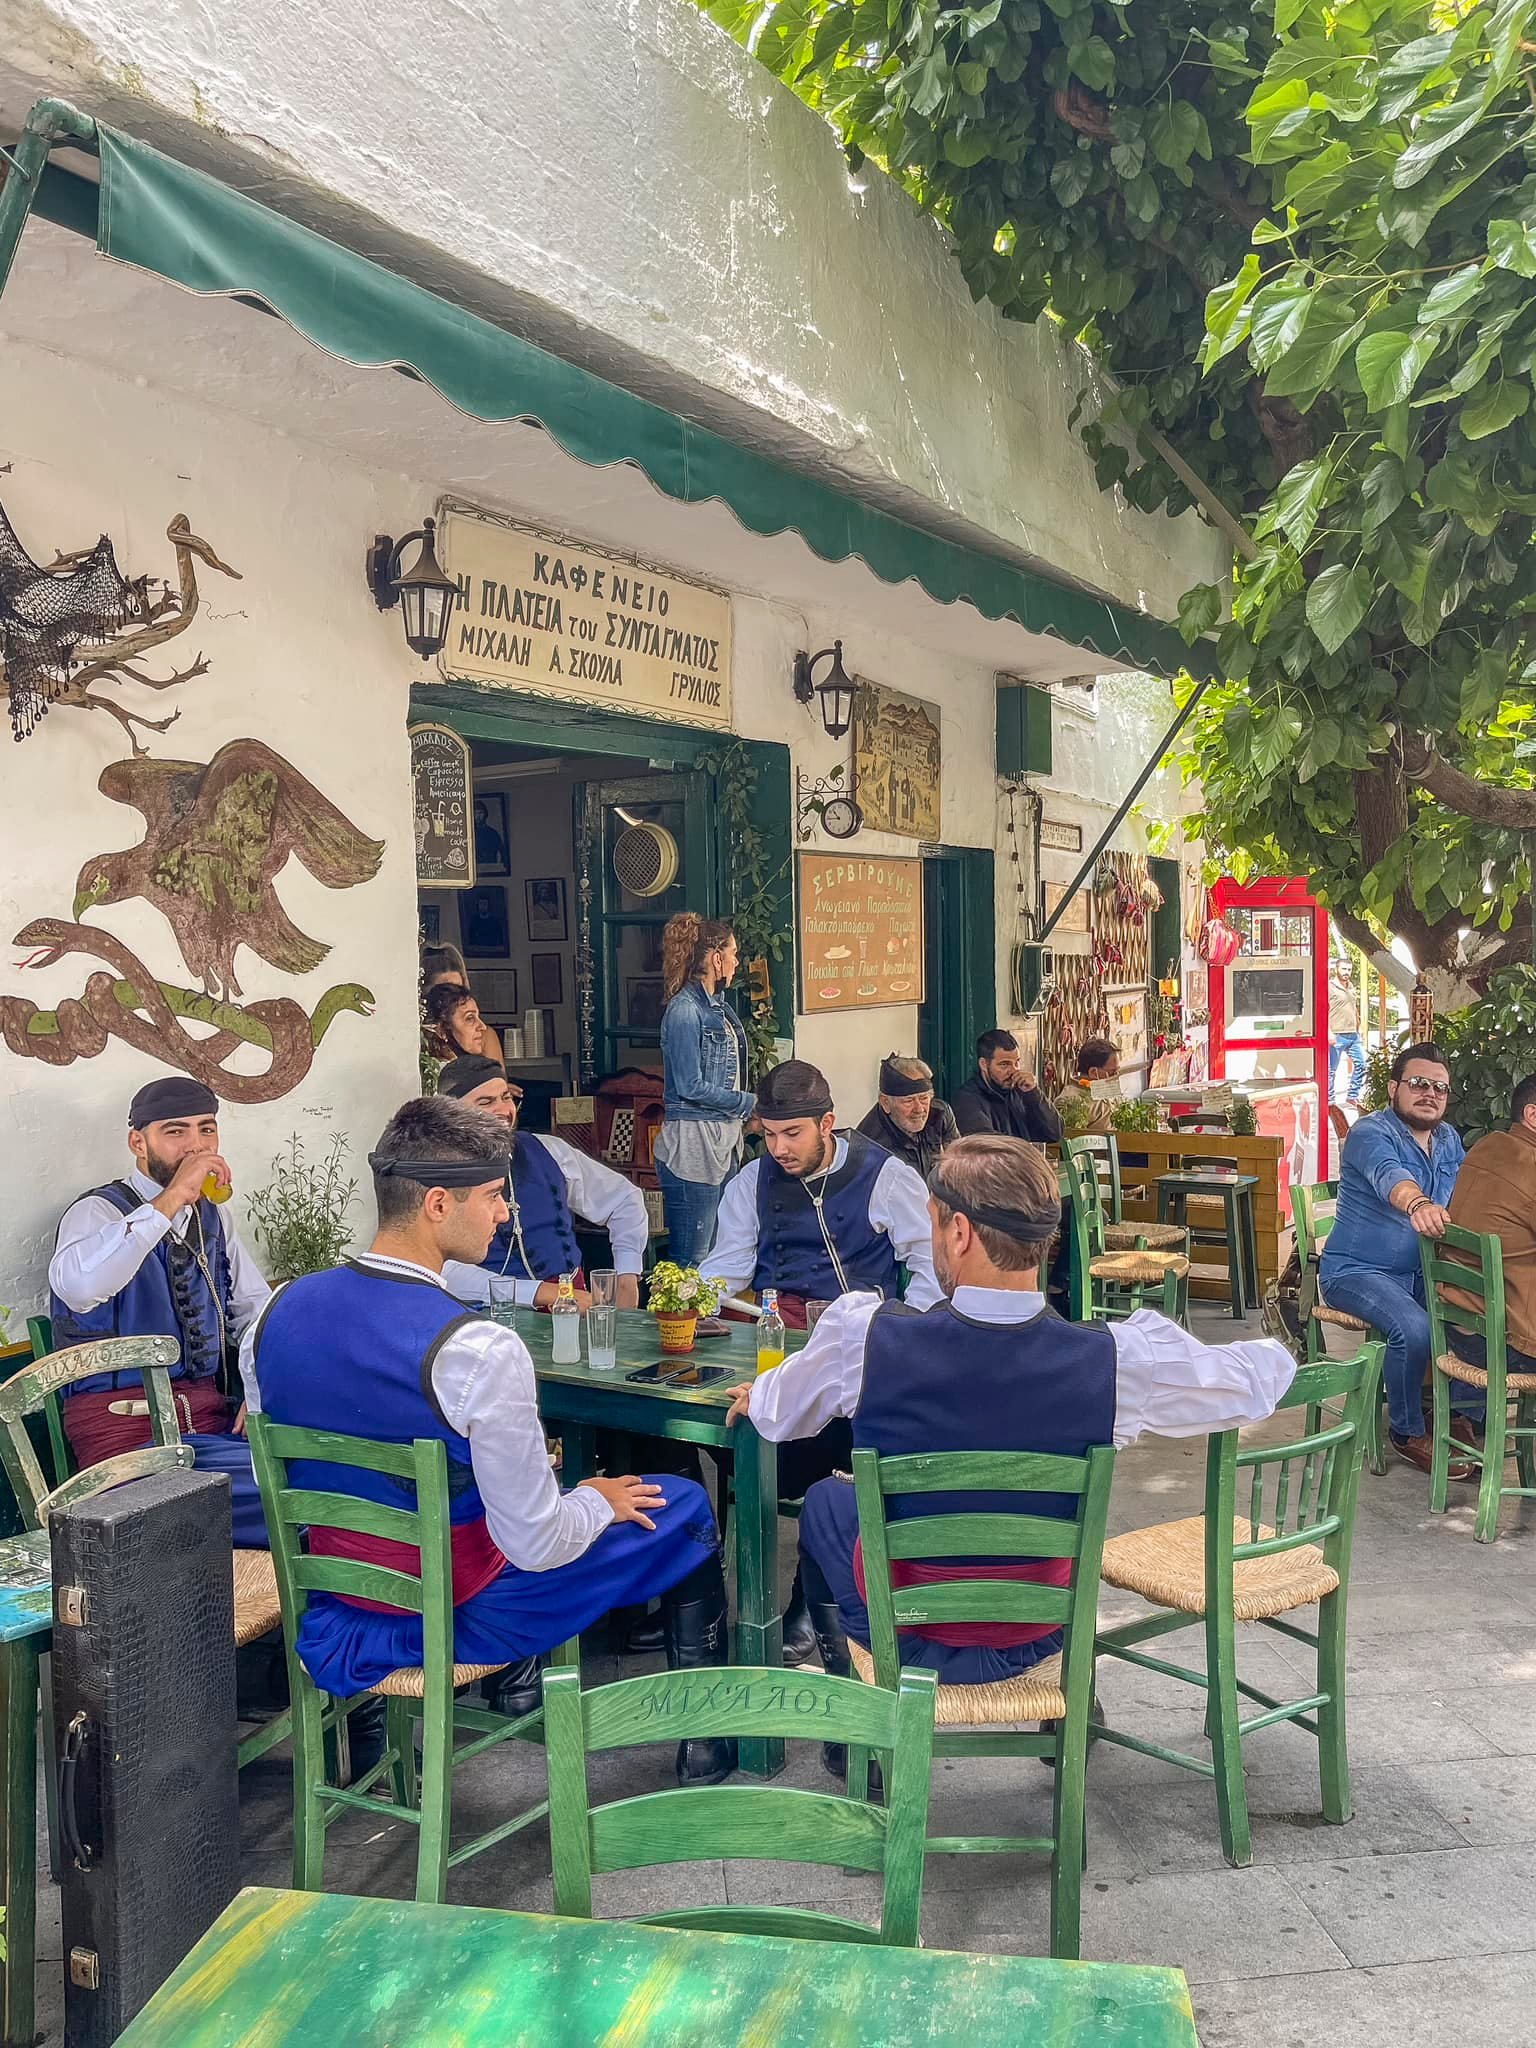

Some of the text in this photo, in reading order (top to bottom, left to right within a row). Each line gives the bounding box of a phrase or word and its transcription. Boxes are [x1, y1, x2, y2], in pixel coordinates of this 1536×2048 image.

[456, 572, 719, 672] Η ΠΛΑΤΕΙΑ του ΣΥΝΤΑΓΜΑΤΟΣ
[533, 551, 669, 616] ΚΑΦΕΝΕΙΟ
[459, 624, 722, 707] ΜΙΧΑΛΗ Α. ΣΚΟΥΛΑ ΓΡΥΛΙΟΣ
